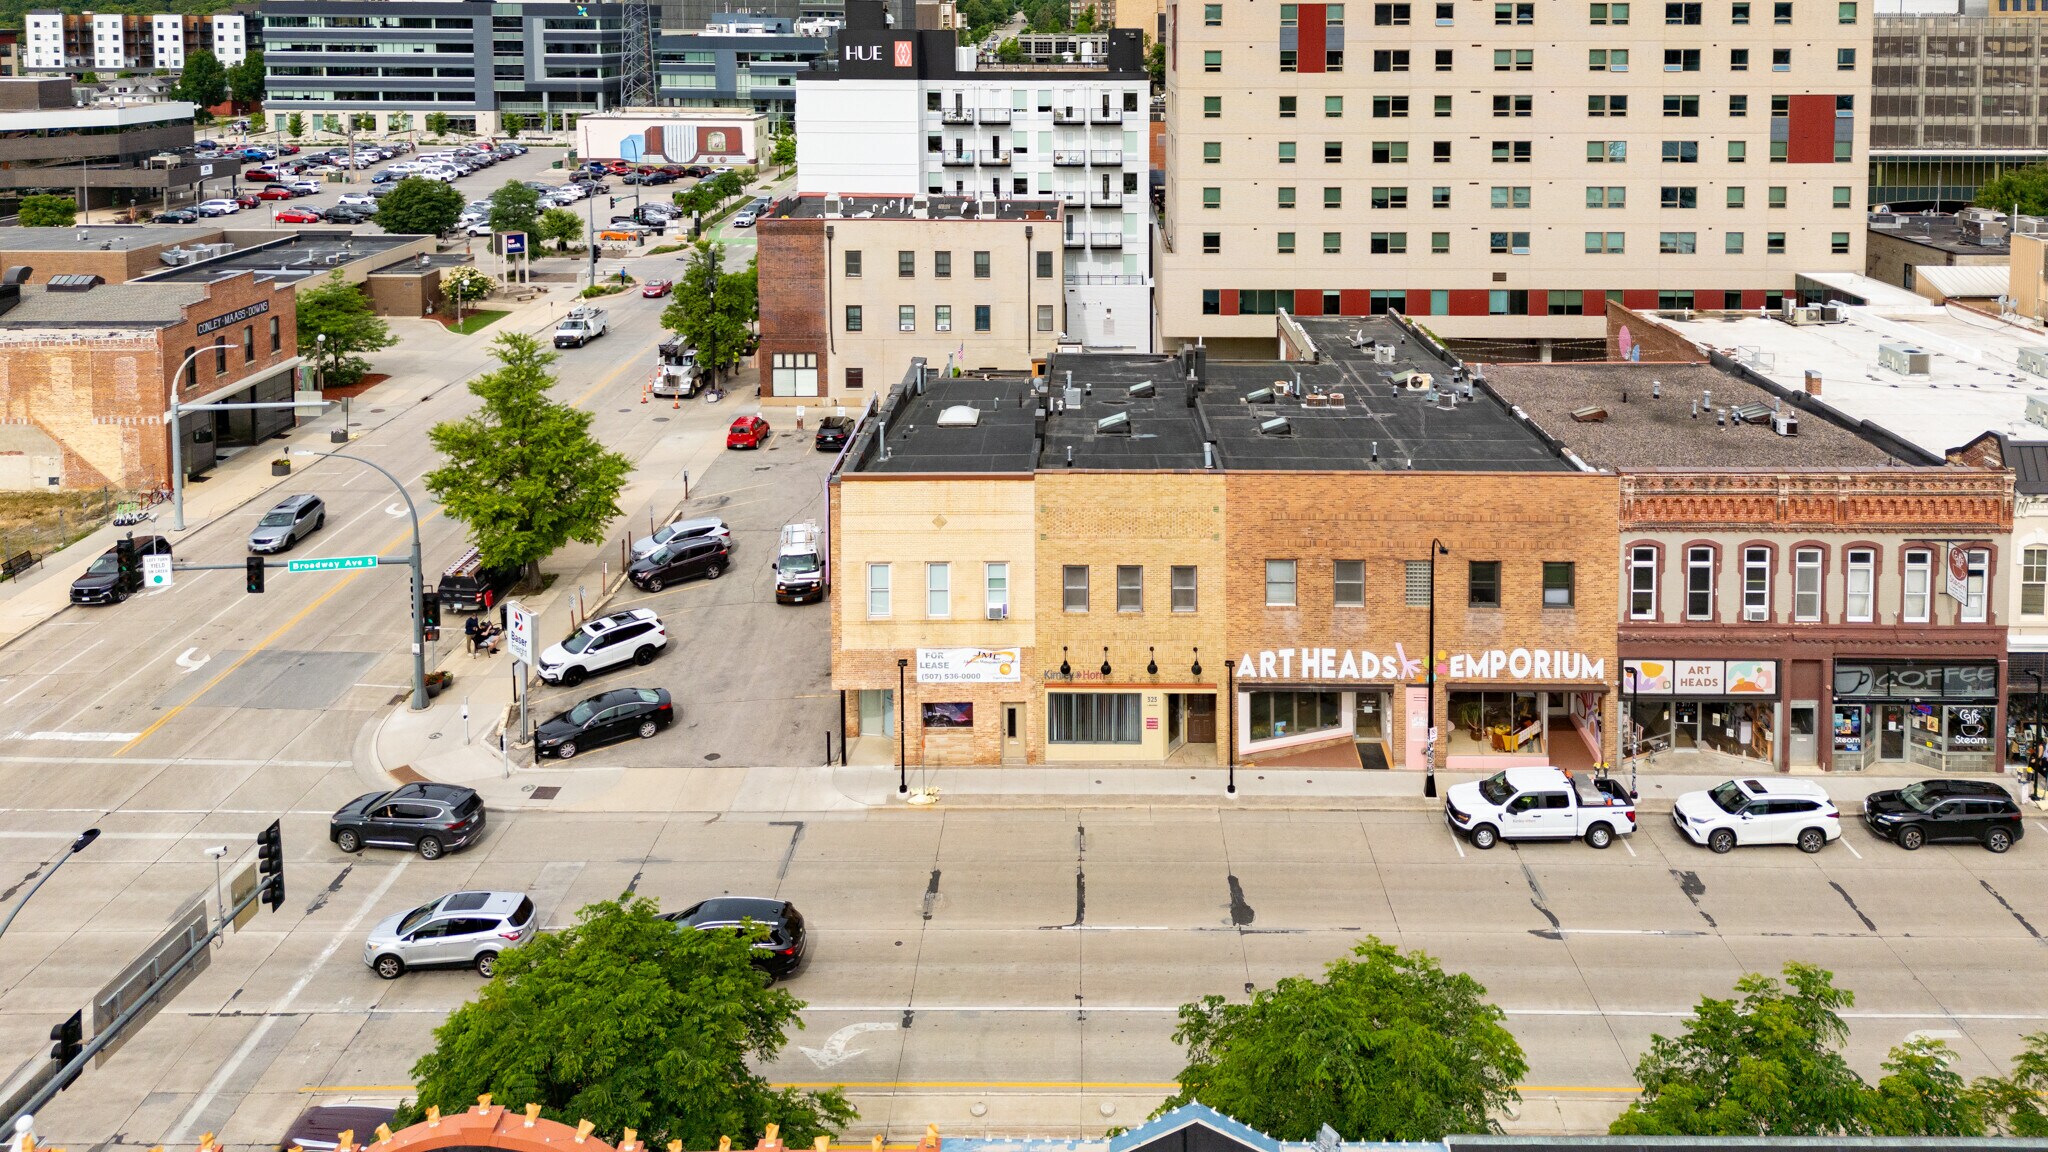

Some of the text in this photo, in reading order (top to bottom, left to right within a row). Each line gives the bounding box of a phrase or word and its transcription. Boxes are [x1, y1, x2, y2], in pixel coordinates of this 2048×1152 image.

[845, 45, 883, 61] HUE
[198, 301, 269, 334] CONLEY MAASS DOWNS
[292, 558, 374, 570] Broadway Ave S
[511, 630, 527, 648] Baser
[919, 661, 950, 669] LEASE
[1235, 647, 1398, 679] ART HEADS
[1449, 647, 1605, 679] EMPORIUM
[944, 672, 981, 680] 536-0000
[1687, 666, 1711, 675] ART
[1875, 666, 1995, 687] COFFEE
[1680, 678, 1718, 687] HEADS
[1834, 736, 1861, 744] Steam
[1954, 735, 1988, 745] Steam
